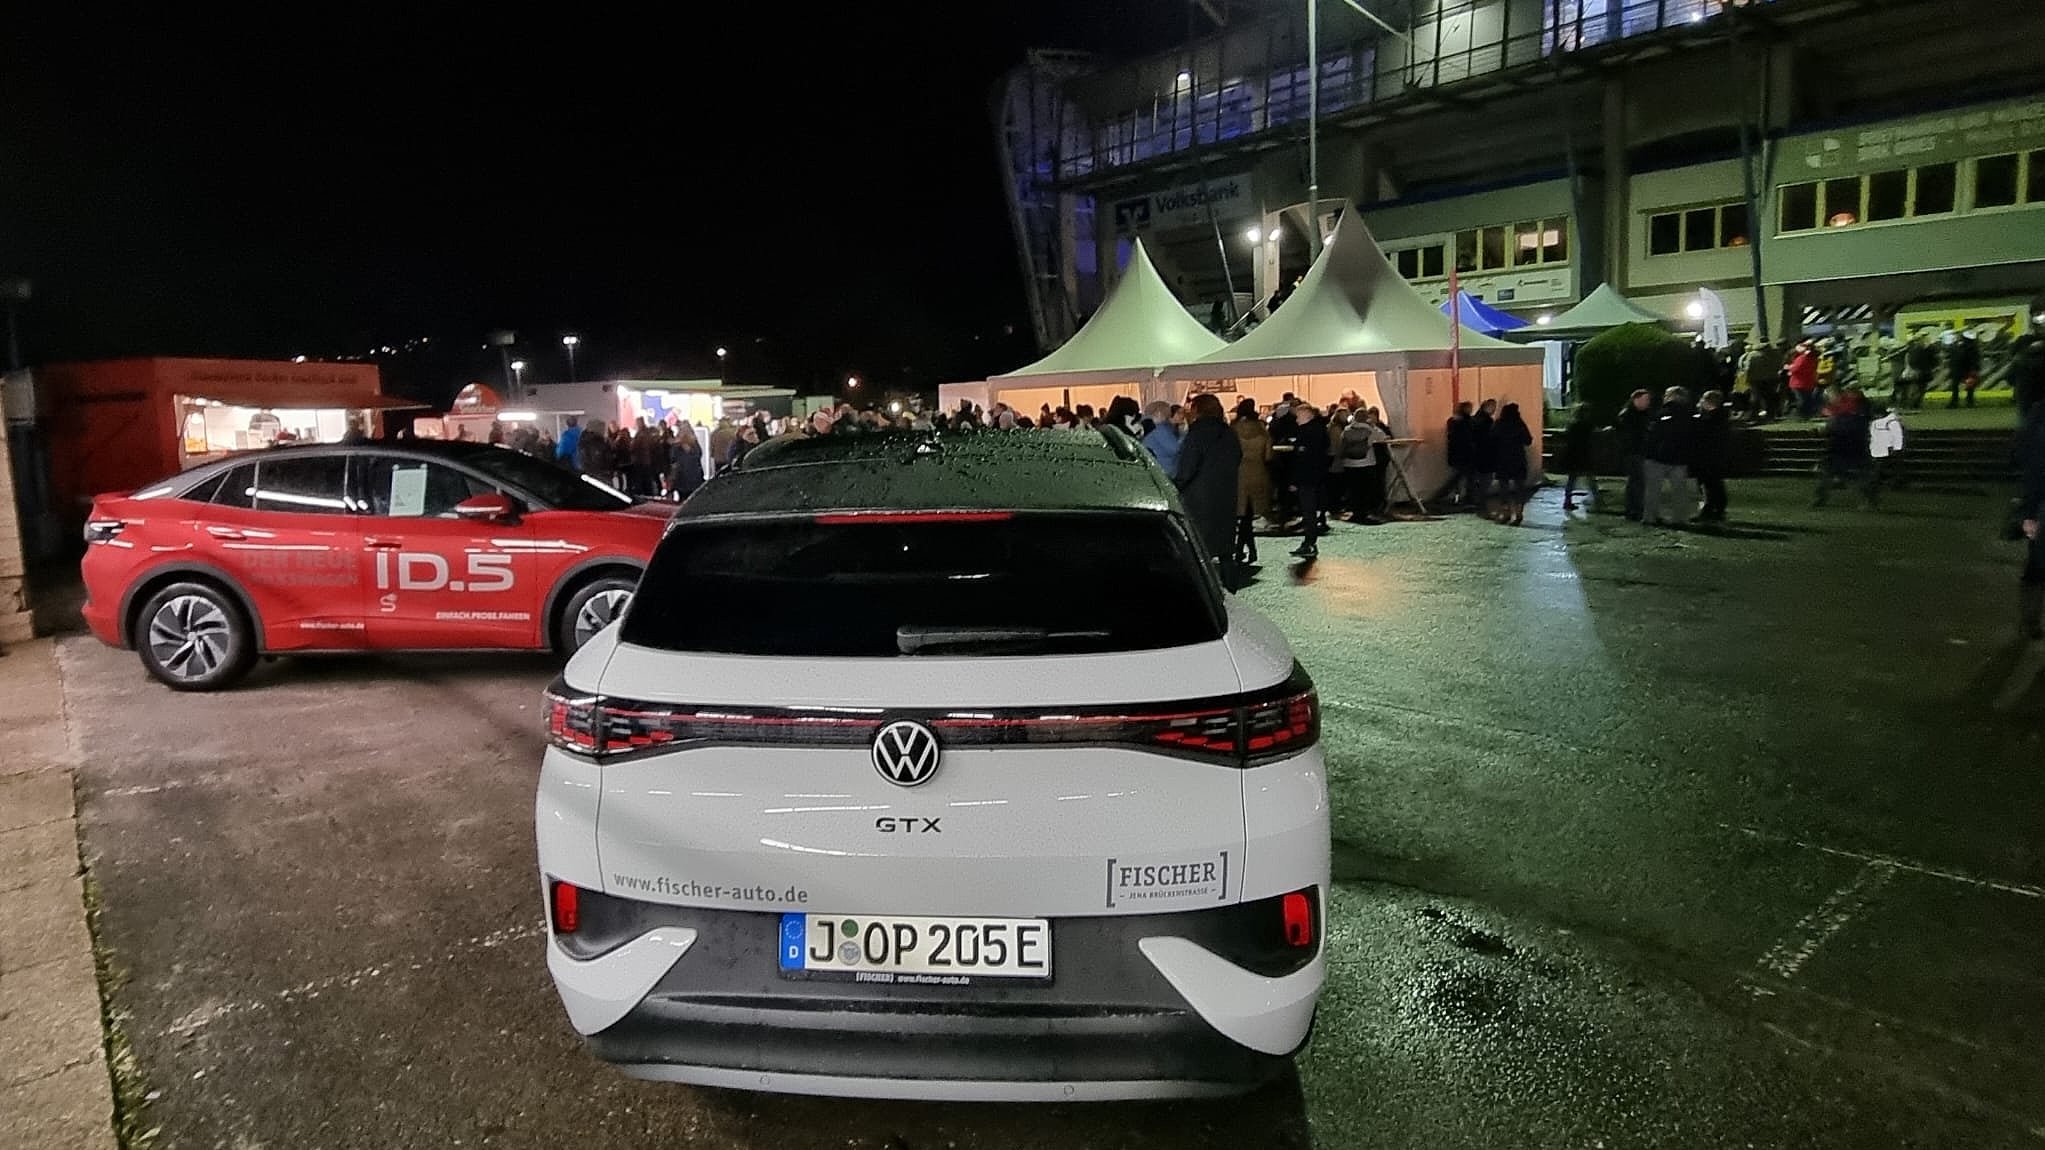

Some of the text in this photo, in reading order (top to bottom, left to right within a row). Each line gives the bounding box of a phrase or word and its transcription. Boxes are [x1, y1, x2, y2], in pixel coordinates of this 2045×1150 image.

[1155, 181, 1239, 213] Volksbank
[376, 551, 514, 592] ID.5
[875, 817, 942, 833] GTX
[613, 872, 809, 904] www.fischer-auto.de
[1119, 862, 1217, 888] FISCHER
[788, 945, 799, 960] D
[809, 920, 835, 963] J
[863, 921, 918, 966] OP
[897, 974, 970, 985] www.fischer-auto.de
